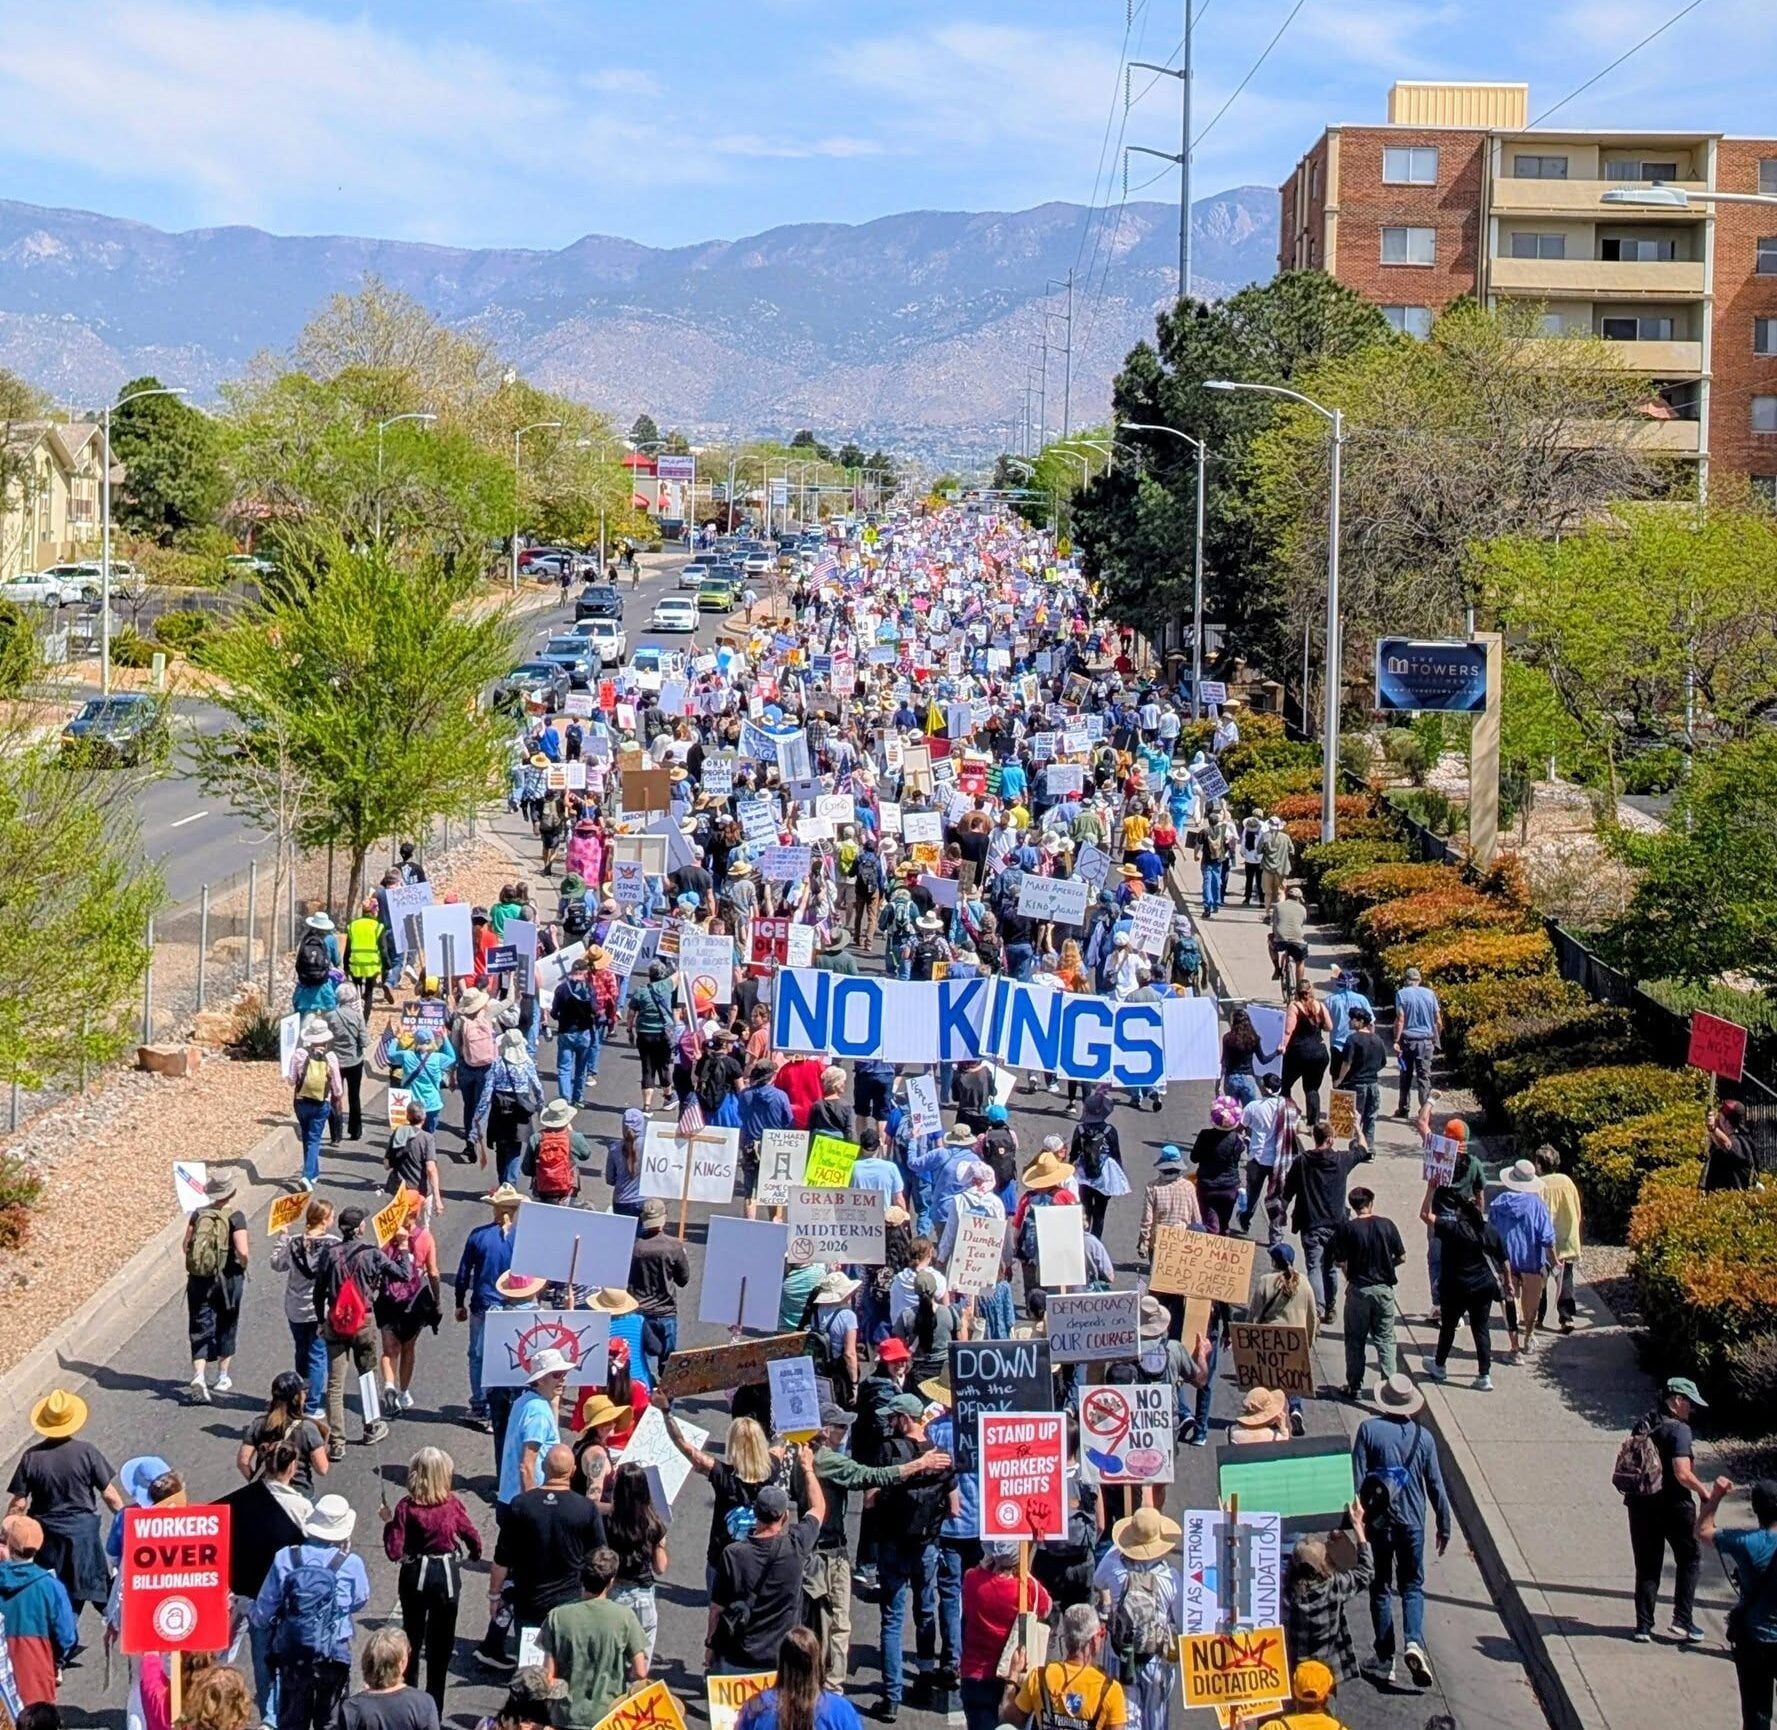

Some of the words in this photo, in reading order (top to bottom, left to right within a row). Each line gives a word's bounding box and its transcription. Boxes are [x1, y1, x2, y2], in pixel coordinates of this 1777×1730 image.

[1410, 664, 1479, 676] TOWERS
[617, 883, 640, 891] SINCE
[1025, 899, 1049, 911] KIND
[1138, 902, 1167, 919] PEOPLE
[754, 920, 786, 938] ICE
[609, 933, 626, 947] SAY
[623, 937, 638, 952] NO
[403, 1017, 416, 1025] NO
[418, 1017, 444, 1026] KINGS
[776, 969, 882, 1057] NO
[938, 978, 1165, 1086] KINGS
[772, 1139, 799, 1147] TIMES
[645, 1157, 668, 1173] NO
[693, 1161, 732, 1178] KINGS
[800, 1192, 845, 1205] GRAB
[377, 1210, 394, 1229] NO
[972, 1216, 990, 1230] We
[795, 1224, 883, 1237] MIDTERMS
[819, 1240, 848, 1252] 2026
[1160, 1228, 1202, 1244] TRUMP
[1206, 1237, 1249, 1254] WOULD
[1158, 1240, 1177, 1252] BE
[1181, 1245, 1203, 1257] SO
[1209, 1250, 1240, 1264] MAD
[964, 1259, 982, 1272] For
[1158, 1251, 1173, 1262] IF
[1179, 1256, 1197, 1267] HE
[1204, 1260, 1246, 1276] COULD
[1156, 1263, 1192, 1280] READ
[1198, 1271, 1236, 1287] THESE
[1052, 1297, 1134, 1315] DEMOCRACY
[1066, 1316, 1106, 1331] depends
[1111, 1317, 1126, 1326] on
[1050, 1333, 1082, 1352] OUR
[1086, 1331, 1136, 1349] COURAGE
[1237, 1327, 1300, 1351] BREAD
[956, 1344, 1038, 1381] DOWN
[1256, 1351, 1289, 1368] NOT
[1237, 1364, 1312, 1390] BALLROOM
[955, 1384, 981, 1398] with
[987, 1383, 1016, 1395] the
[1136, 1388, 1162, 1410] NO
[1130, 1410, 1169, 1430] KINGS
[986, 1423, 1035, 1446] STAND
[1038, 1421, 1058, 1441] UP
[1128, 1431, 1154, 1449] NO
[988, 1456, 1060, 1479] WORKERS'
[1000, 1477, 1050, 1497] RIGHTS
[134, 1515, 220, 1539] WORKERS
[1188, 1517, 1204, 1569] STRONG
[133, 1543, 218, 1569] OVER
[132, 1571, 219, 1590] BILLIONAIRES
[1257, 1514, 1279, 1627] OUNDATION
[1187, 1587, 1203, 1607] AS
[1191, 1638, 1227, 1672] NO
[1193, 1667, 1280, 1697] DICTATORS
[718, 1682, 746, 1707] NO
